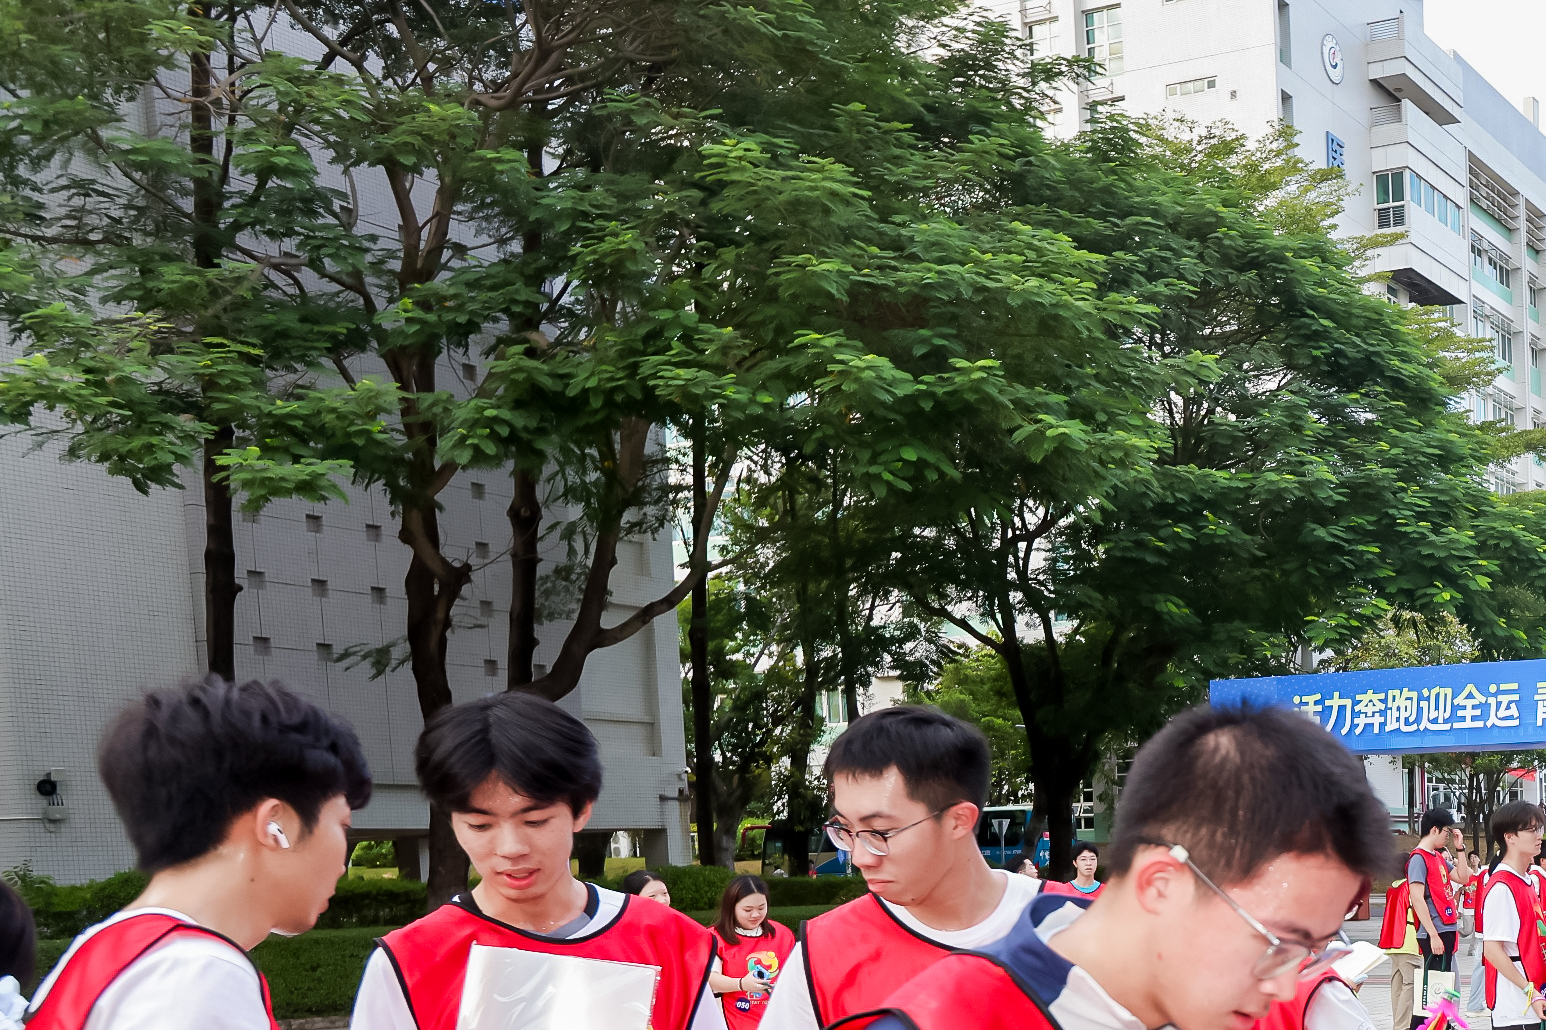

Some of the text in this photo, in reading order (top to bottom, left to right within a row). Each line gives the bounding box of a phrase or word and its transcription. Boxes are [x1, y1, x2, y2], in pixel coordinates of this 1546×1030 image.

[1292, 682, 1520, 736] 活力奔跑迎全运
